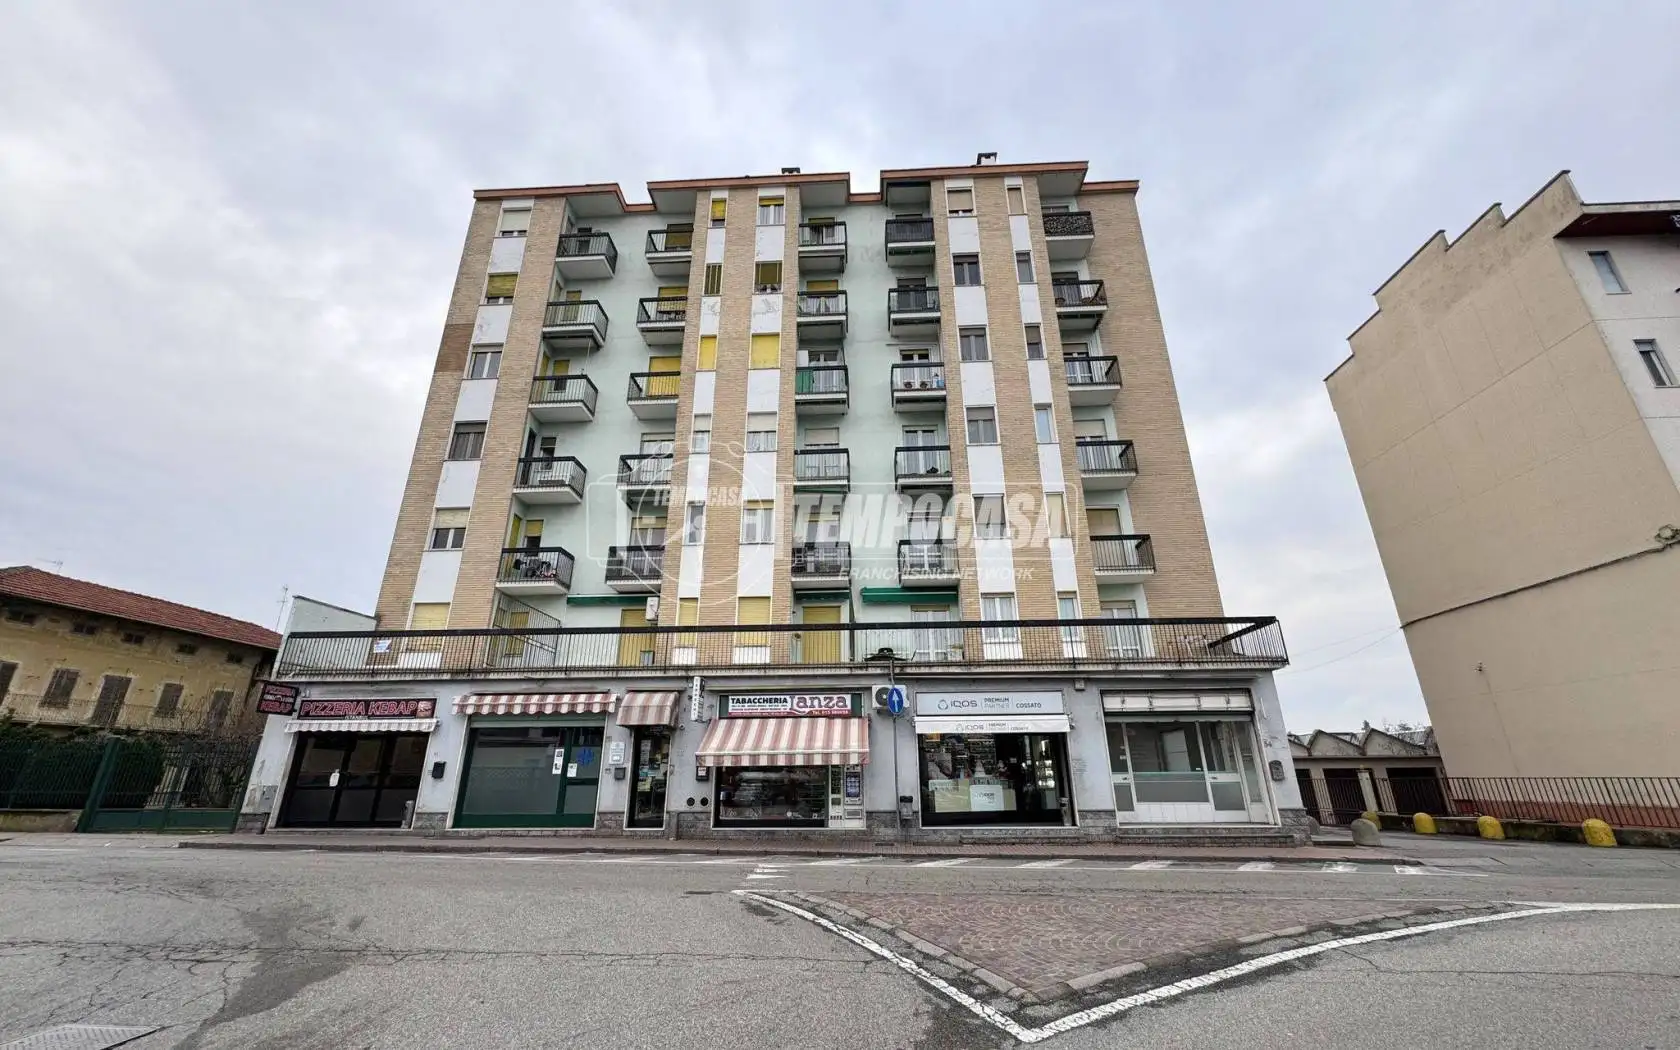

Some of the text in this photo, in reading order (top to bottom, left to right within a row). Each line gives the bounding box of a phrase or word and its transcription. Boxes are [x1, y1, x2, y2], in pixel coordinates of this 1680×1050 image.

[300, 701, 418, 716] PIZZERIA KEBAP
[789, 695, 848, 714] Lanza
